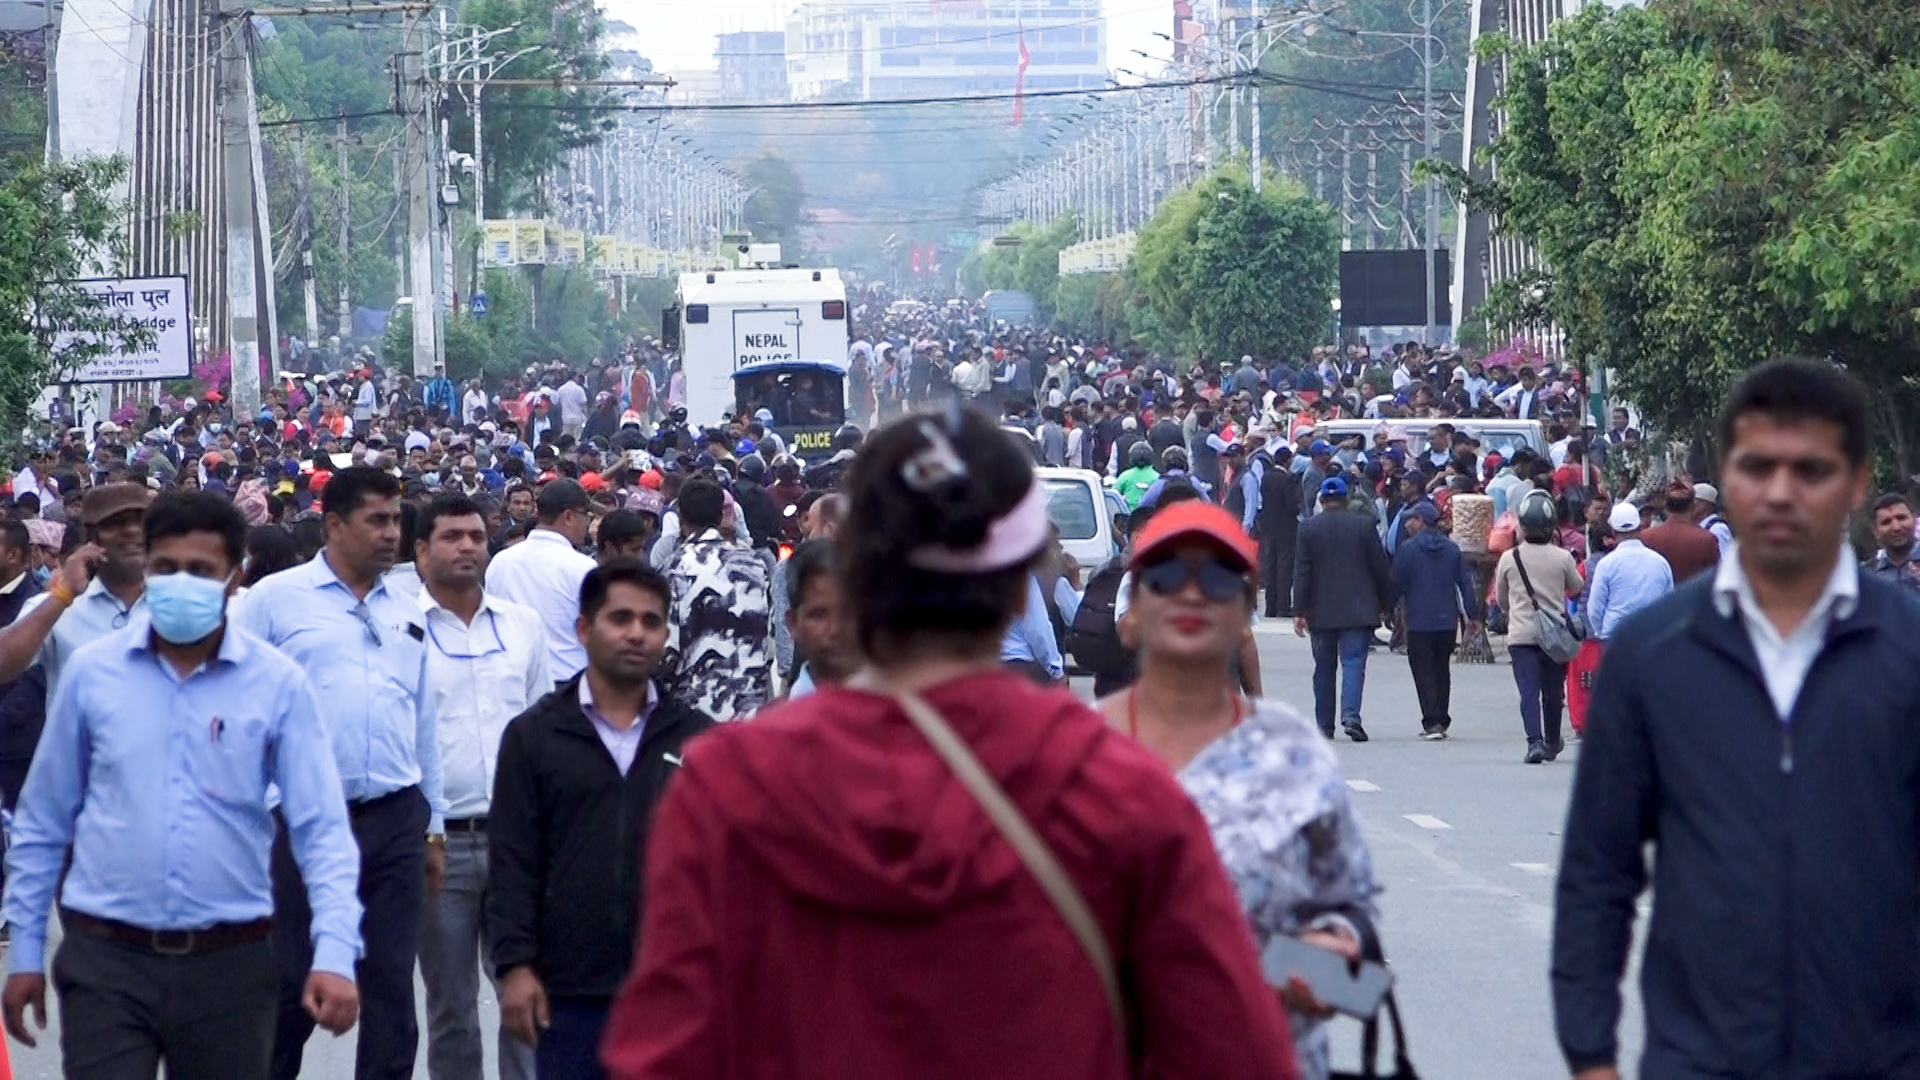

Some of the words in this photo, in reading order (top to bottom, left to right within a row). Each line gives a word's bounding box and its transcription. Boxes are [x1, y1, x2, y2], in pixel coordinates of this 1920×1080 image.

[140, 289, 171, 311] पुल
[745, 333, 788, 348] NEPAL
[794, 431, 832, 448] POLICE
